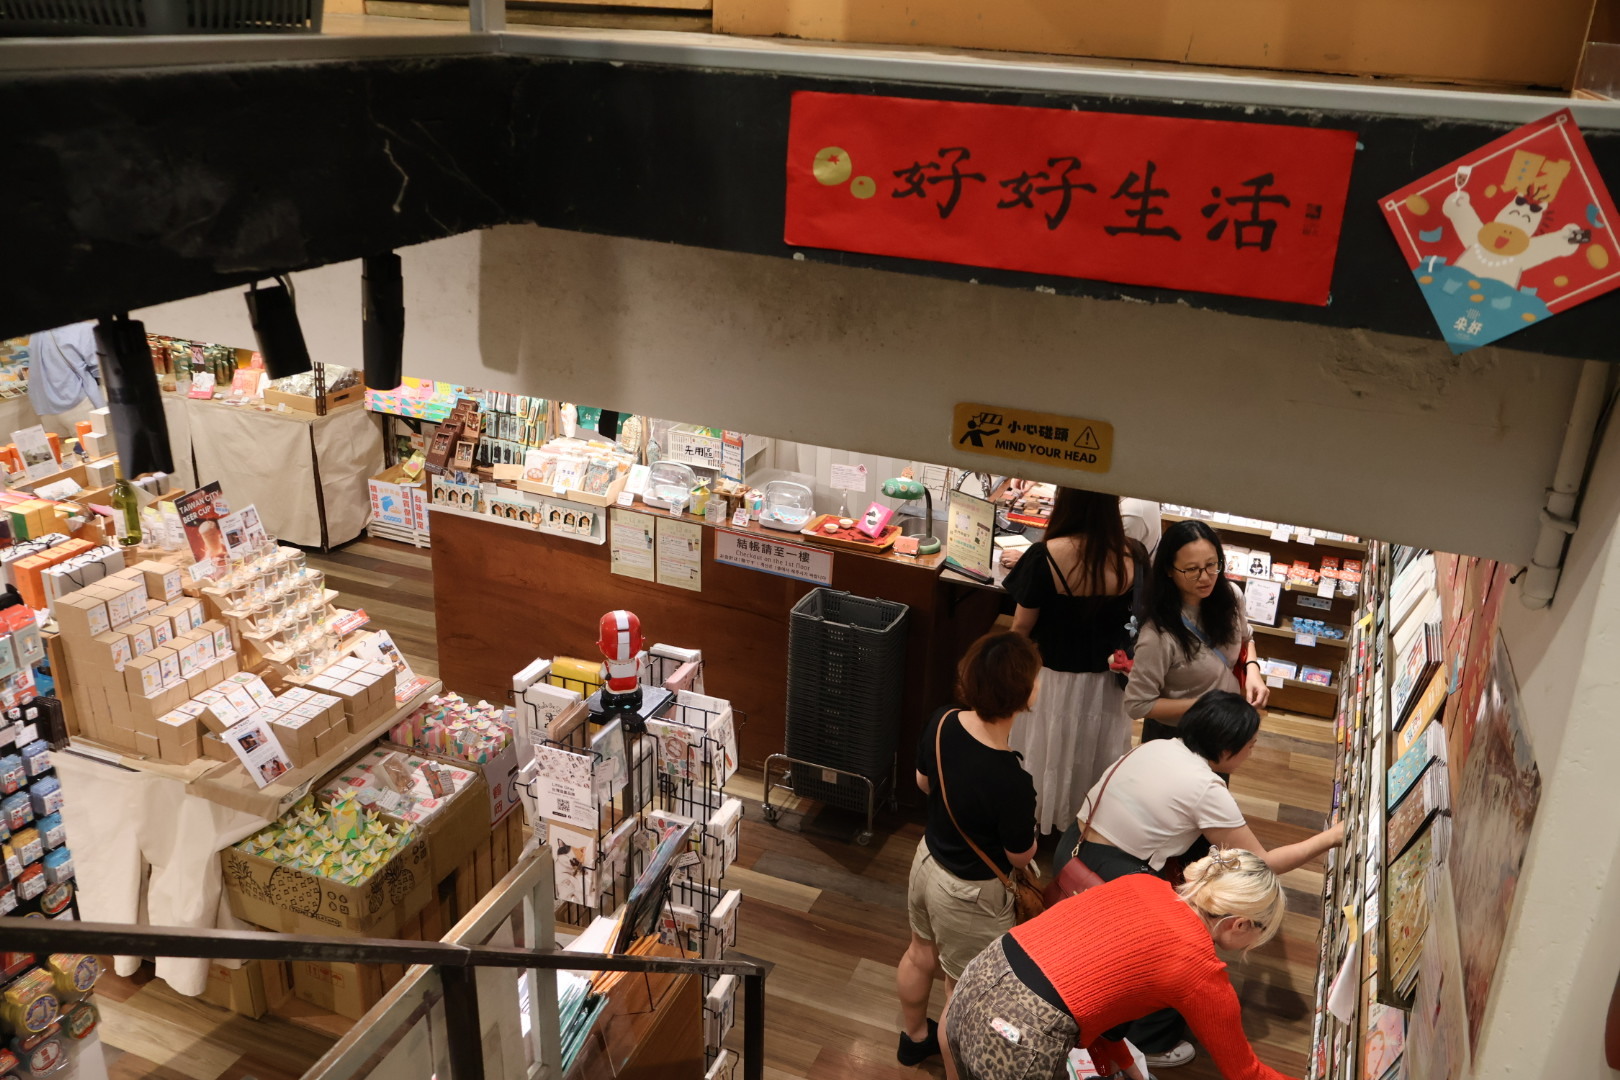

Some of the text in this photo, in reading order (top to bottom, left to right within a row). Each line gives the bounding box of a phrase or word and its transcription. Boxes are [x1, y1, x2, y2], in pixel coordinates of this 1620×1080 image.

[891, 147, 1291, 252] 好好生活
[1007, 420, 1070, 442] 小心碰頭
[995, 439, 1097, 464] MIND YOUR HEAD
[179, 490, 220, 514] TAIWAN CITY
[182, 506, 211, 524] BEER CUP
[735, 550, 762, 562] Checkout
[773, 557, 783, 565] the
[796, 562, 810, 571] floor
[737, 538, 810, 563] 結帳請至一樓
